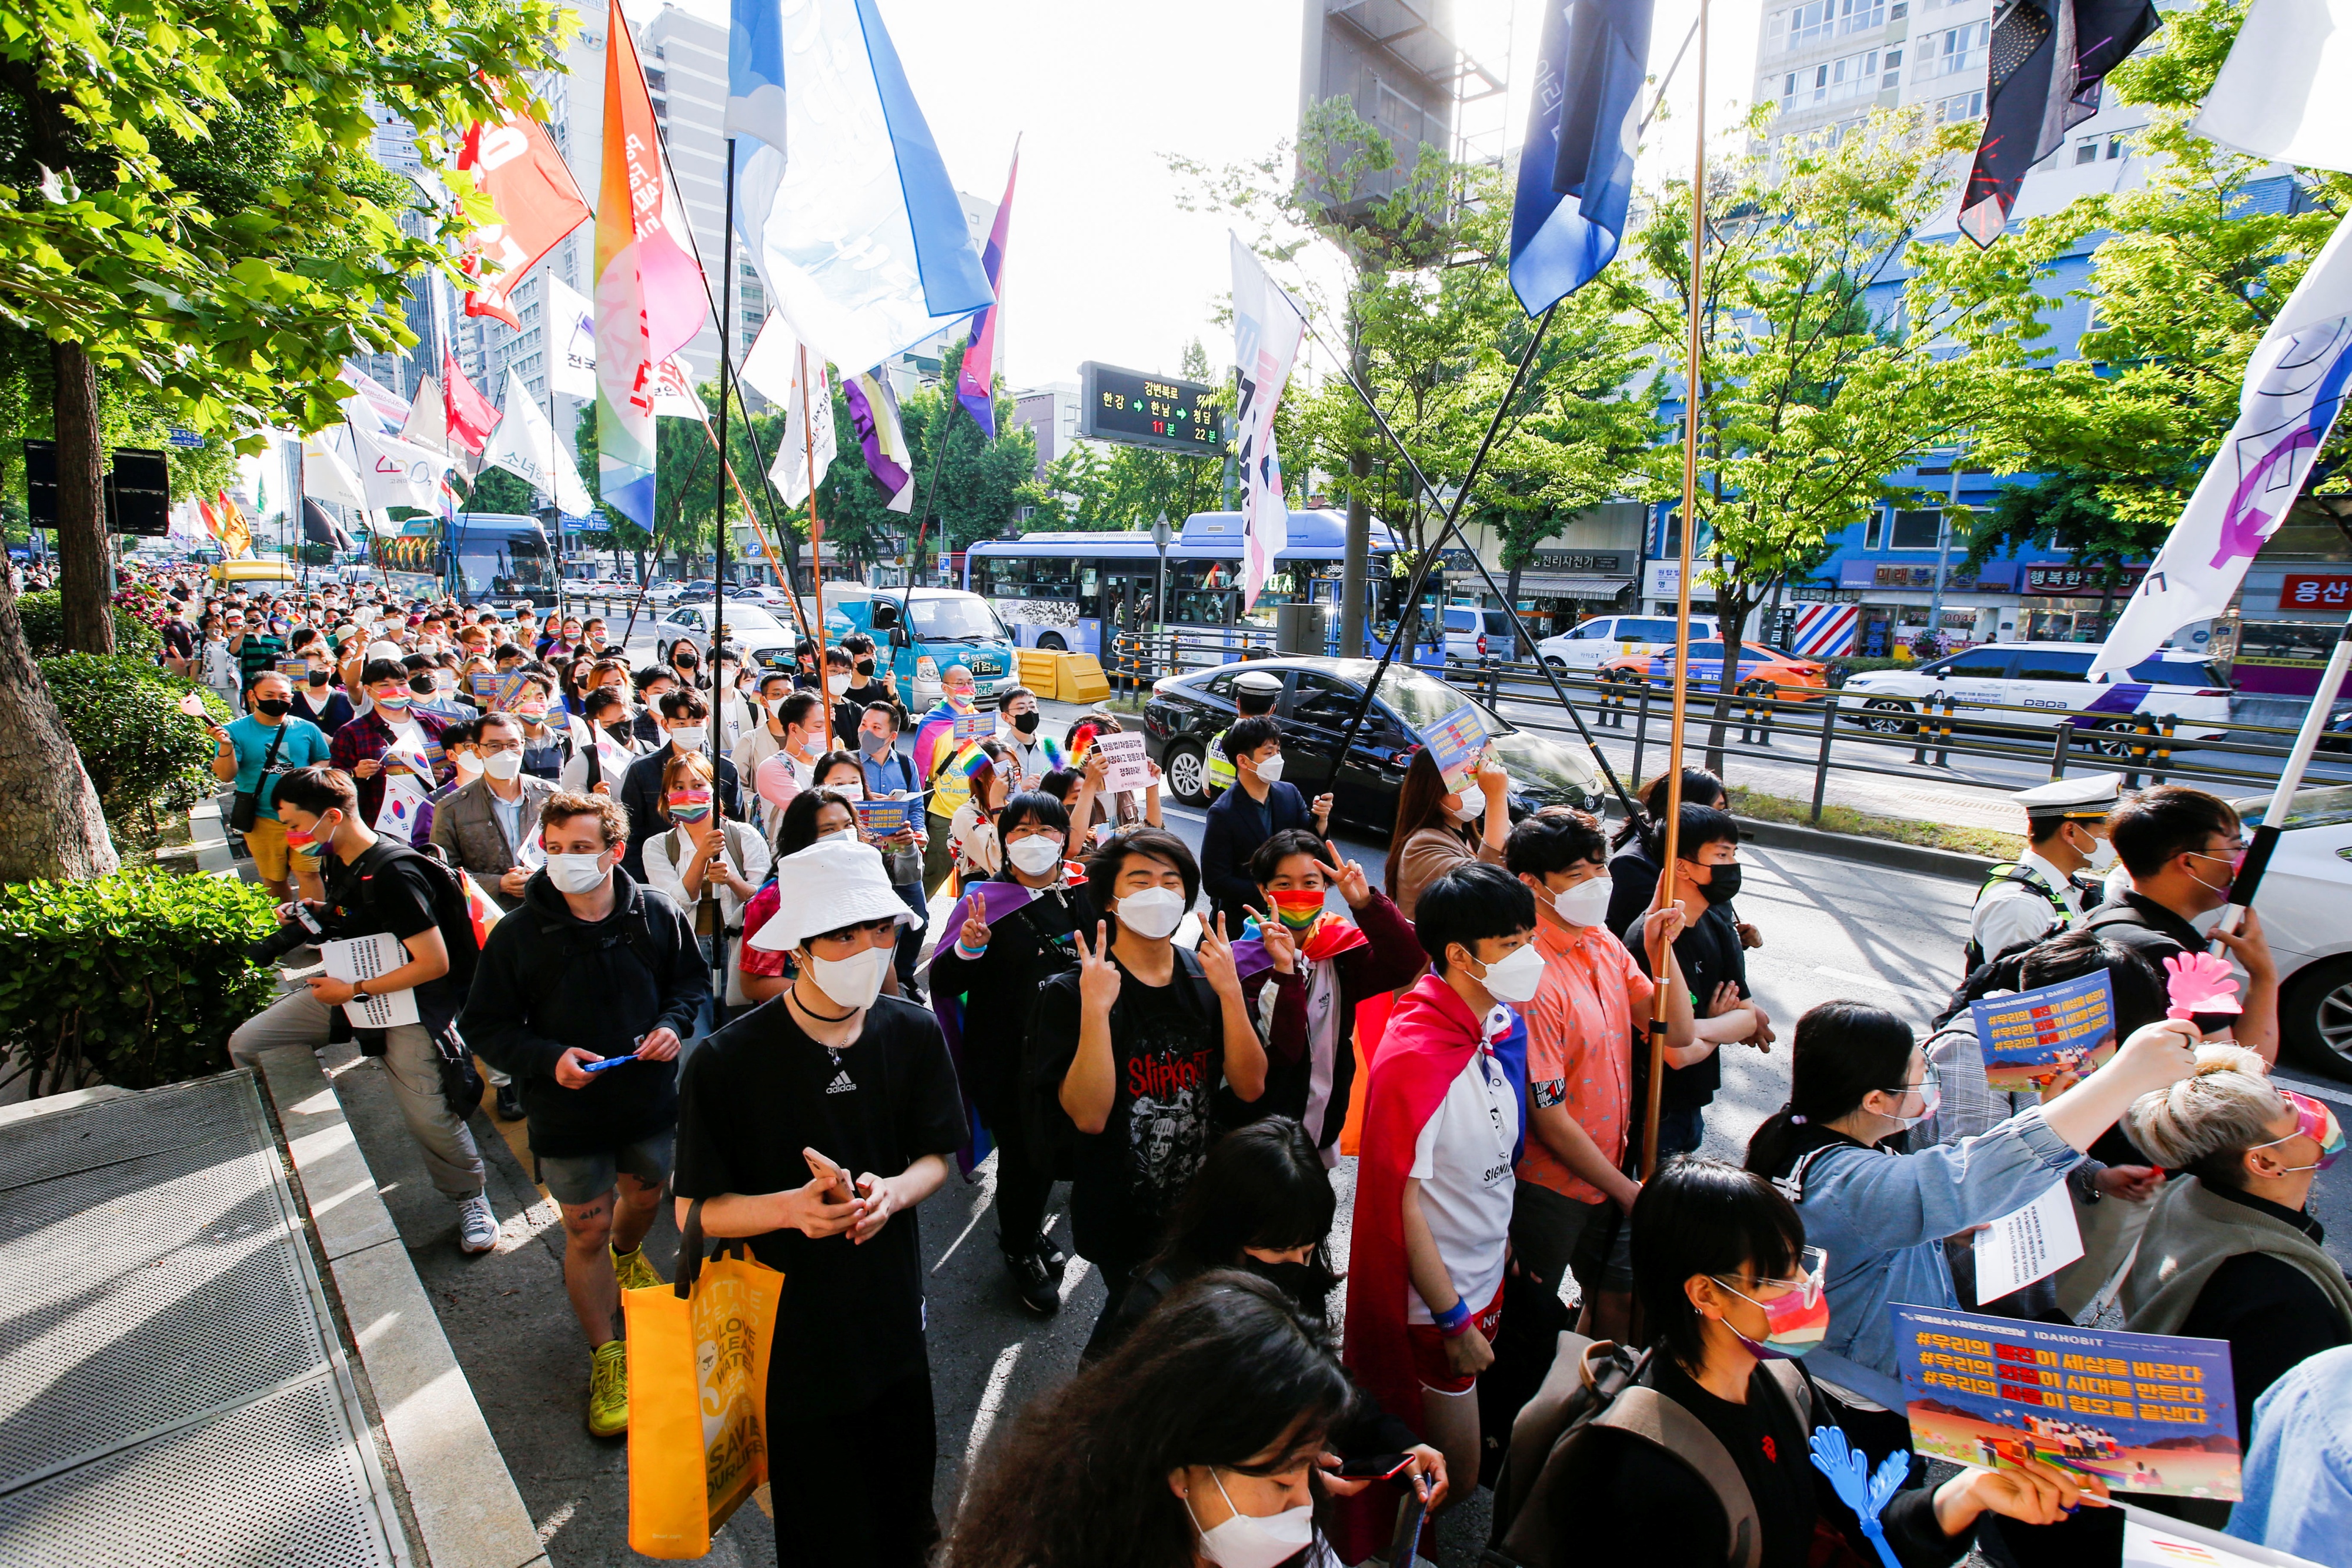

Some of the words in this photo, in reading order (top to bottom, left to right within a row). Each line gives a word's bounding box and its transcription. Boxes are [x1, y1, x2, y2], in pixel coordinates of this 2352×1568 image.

[1144, 381, 1179, 400] 강변북로
[1102, 391, 1125, 410] 한강
[1150, 401, 1171, 418] 한남
[1192, 409, 1212, 426] 청담
[1152, 420, 1164, 434] 11
[1167, 423, 1176, 437] 분
[1194, 427, 1206, 441] 22
[1208, 430, 1217, 443] 분
[2030, 570, 2082, 585] 행복한
[1911, 611, 1977, 623] 79-0044
[2024, 699, 2067, 708] papa
[1127, 753, 1141, 762] 평등의
[1119, 766, 1141, 777] 쟁취하자!
[2046, 986, 2075, 998] IDAHOBIT
[1987, 1010, 2030, 1026] #우리의
[2062, 995, 2086, 1011] 세상을
[2084, 988, 2107, 1004] 바꾼다
[1991, 1023, 2034, 1039] #우리의
[2066, 1008, 2089, 1025] 시대를
[1994, 1036, 2038, 1052] #우리의
[2069, 1022, 2091, 1038] 혐오를
[826, 1084, 857, 1094] adidas
[2033, 1330, 2103, 1348] IDAHOBIT
[1916, 1331, 1992, 1358] #우리의
[1994, 1342, 2059, 1368] 행진이
[2062, 1351, 2129, 1377] 세상을
[2133, 1360, 2203, 1384] 바꾼다
[1919, 1350, 1995, 1378] #우리의
[1997, 1363, 2062, 1389] 외침이
[2066, 1373, 2133, 1399] 시대를
[2136, 1382, 2206, 1405] 만든다
[1923, 1370, 1998, 1398] #우리의
[2001, 1383, 2065, 1410] 싸움이
[2069, 1395, 2135, 1419] 혐오를
[2139, 1402, 2208, 1424] 끝낸다
[709, 1414, 760, 1470] SAVE
